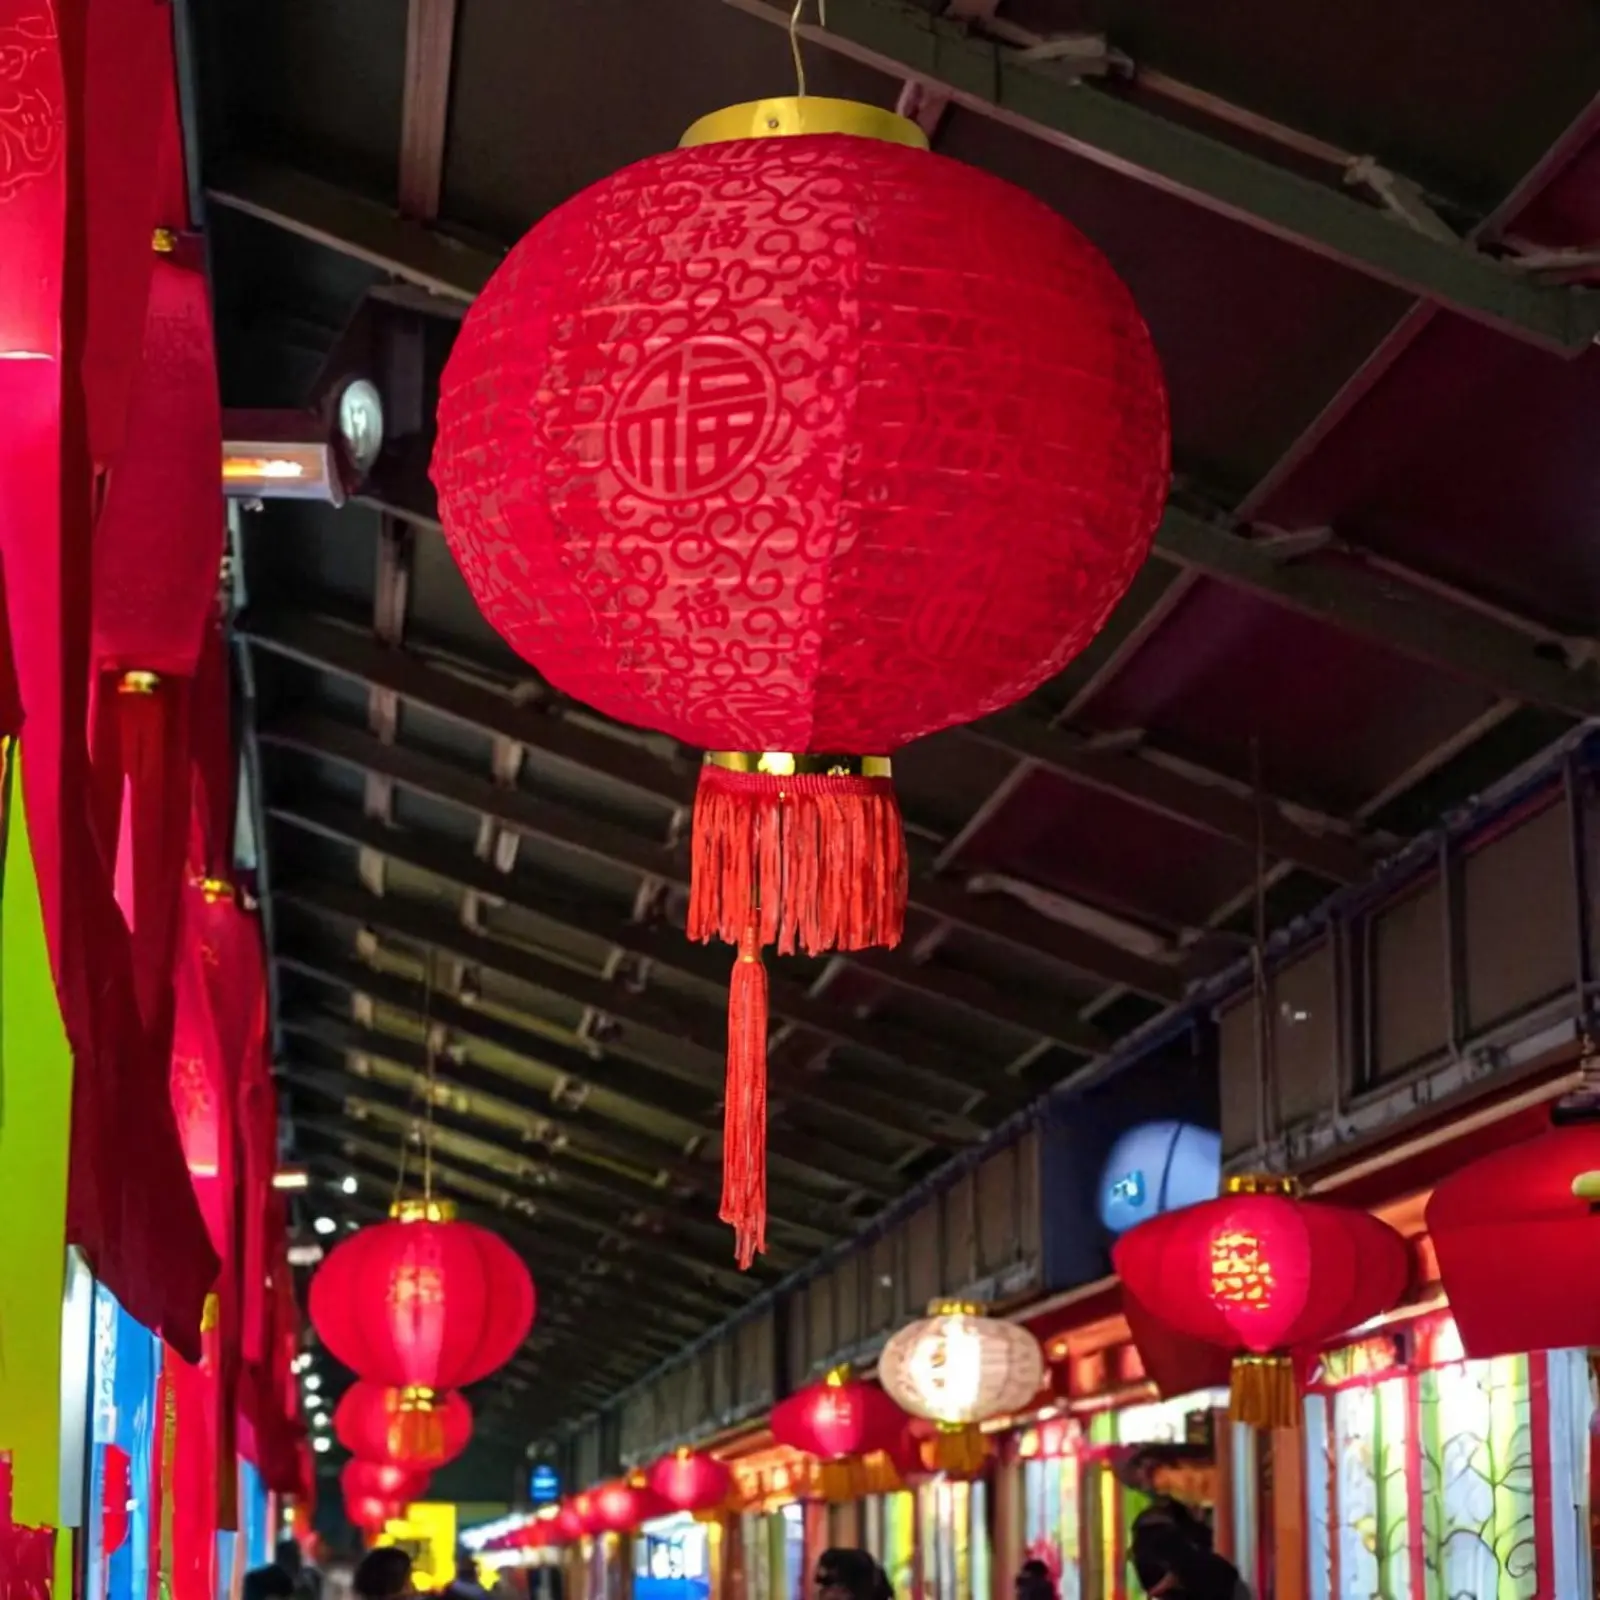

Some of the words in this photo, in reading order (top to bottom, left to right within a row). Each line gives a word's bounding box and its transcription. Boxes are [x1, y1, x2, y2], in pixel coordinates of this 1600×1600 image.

[685, 205, 749, 254] 福
[615, 343, 770, 494] 福
[672, 577, 730, 634] 福
